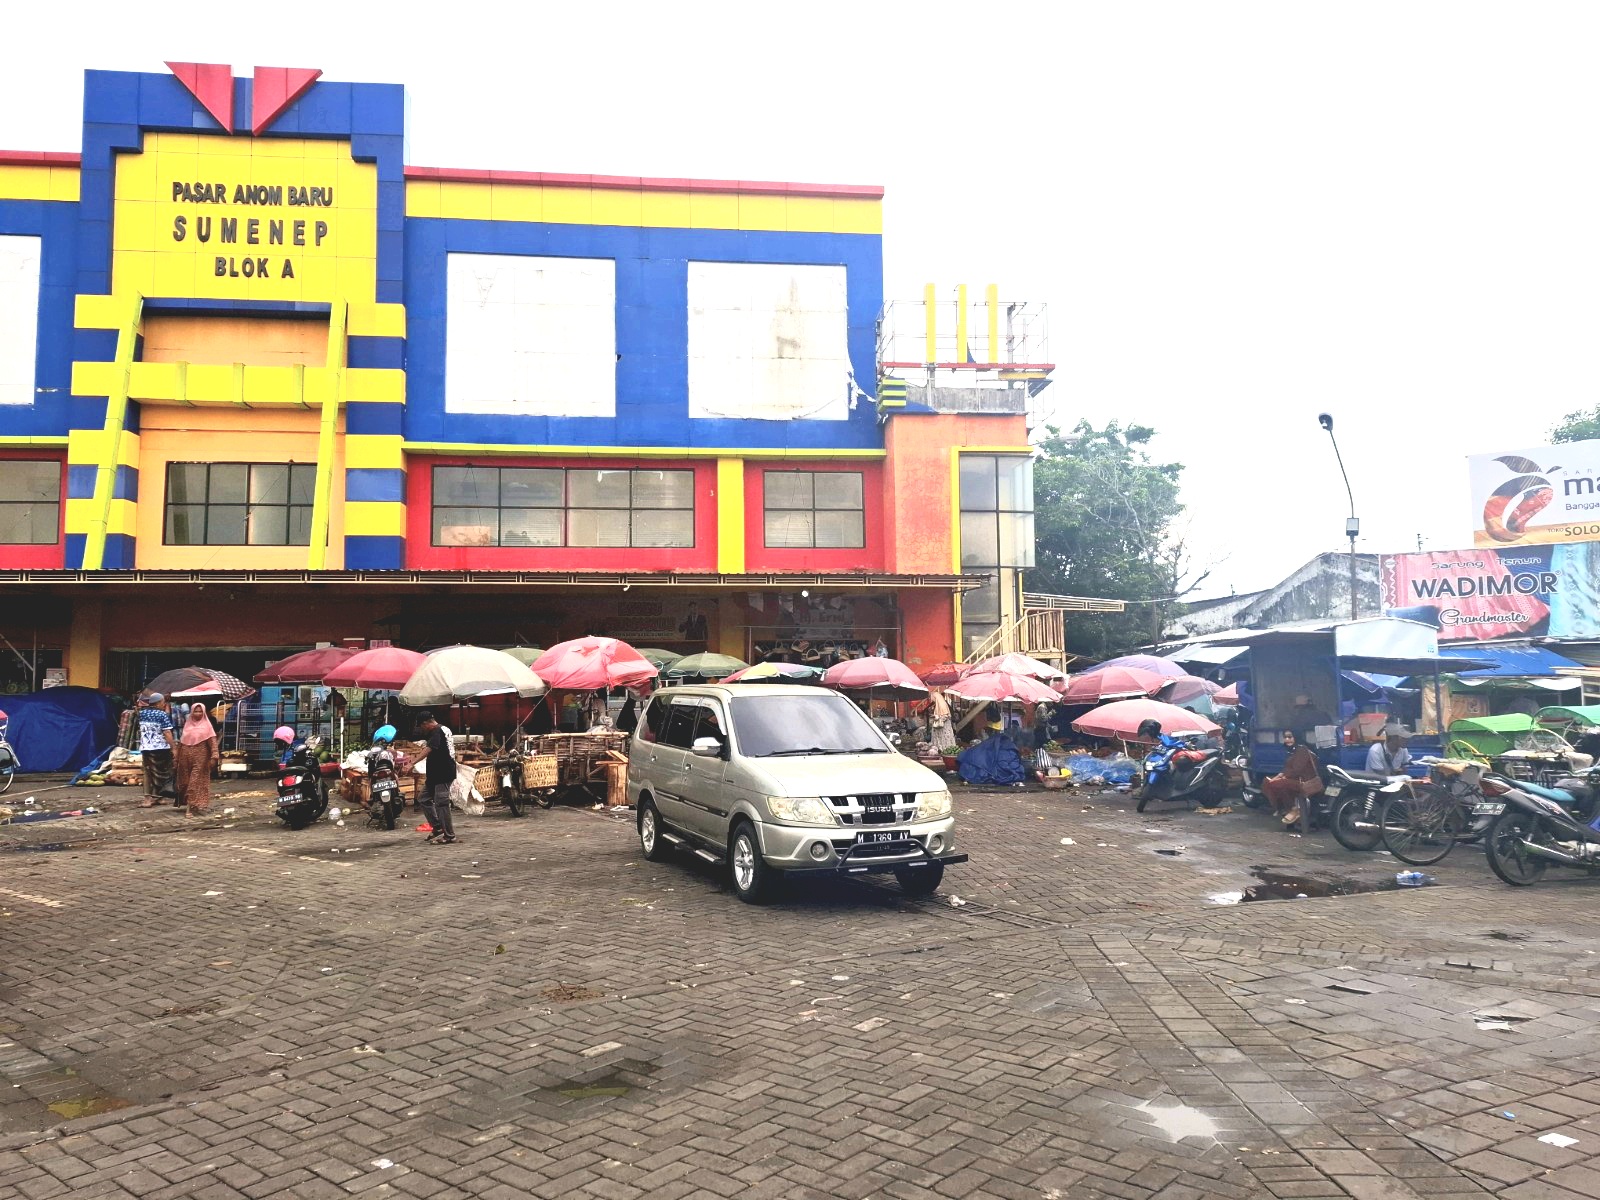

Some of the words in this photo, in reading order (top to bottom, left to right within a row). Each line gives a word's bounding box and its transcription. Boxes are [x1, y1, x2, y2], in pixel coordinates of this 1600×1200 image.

[172, 182, 226, 204] PASAR
[233, 184, 282, 205] ANOM
[287, 186, 333, 207] BARU
[173, 216, 327, 246] SUMENEP
[214, 256, 270, 278] BLOK
[281, 259, 295, 279] A
[1563, 476, 1600, 497] m
[1431, 560, 1485, 571] Sarung
[1496, 556, 1542, 567] Tenun
[1411, 571, 1558, 599] WADIMOR
[1438, 607, 1529, 627] Grandmaster
[857, 833, 864, 844] M
